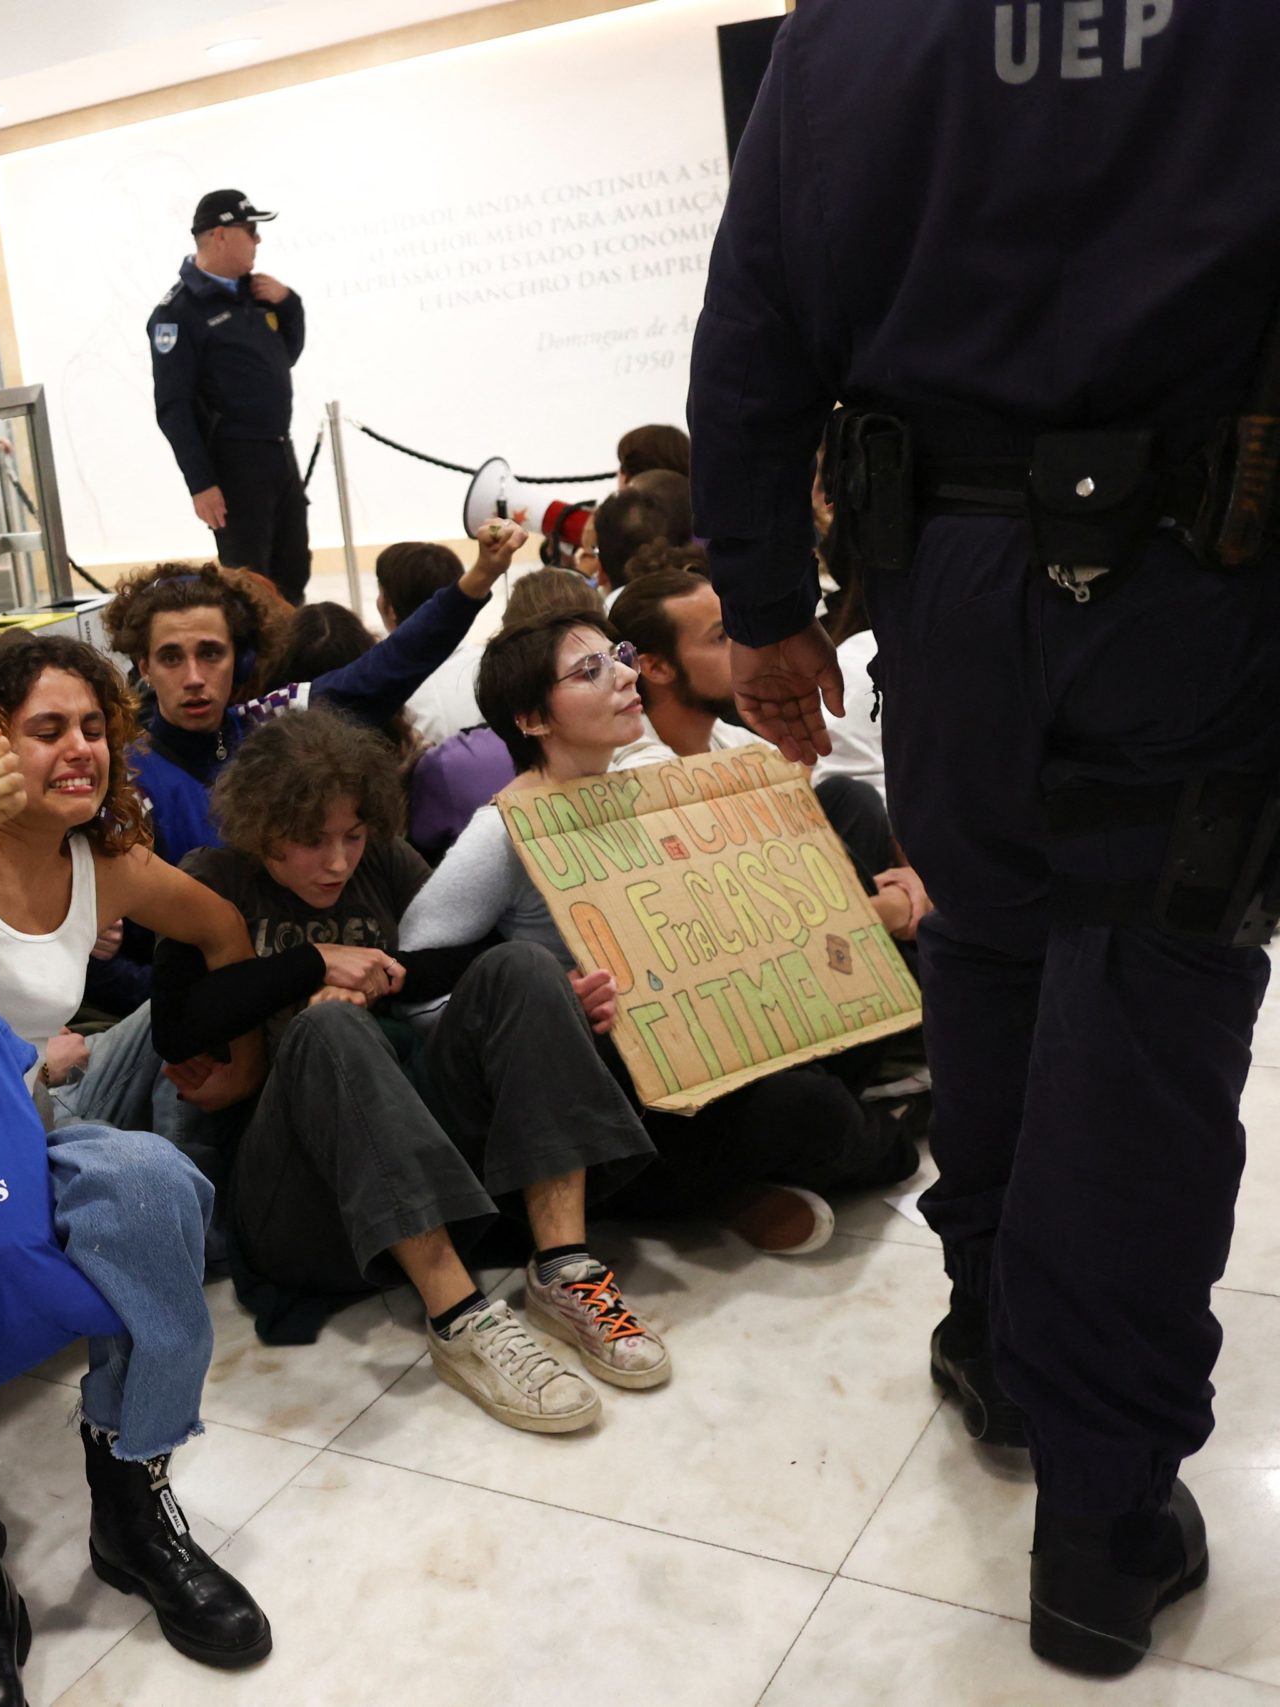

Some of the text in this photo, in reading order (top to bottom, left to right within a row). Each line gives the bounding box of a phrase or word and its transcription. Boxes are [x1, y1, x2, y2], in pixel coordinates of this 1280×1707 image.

[994, 0, 1173, 84] UEP
[464, 193, 535, 221] AINDA
[541, 168, 670, 206] CONTINUA
[675, 163, 693, 184] A
[392, 229, 478, 257] MELHOR
[487, 219, 543, 247] MEIO
[551, 208, 606, 235] PARA
[459, 256, 493, 276] DO
[499, 242, 586, 272] ESTADO
[436, 273, 571, 309] FINANCEIRO
[578, 268, 621, 289] DAS
[536, 325, 639, 353] Domingues
[645, 314, 669, 338] de
[569, 901, 636, 996] O
[162, 1493, 176, 1514] MASKED
